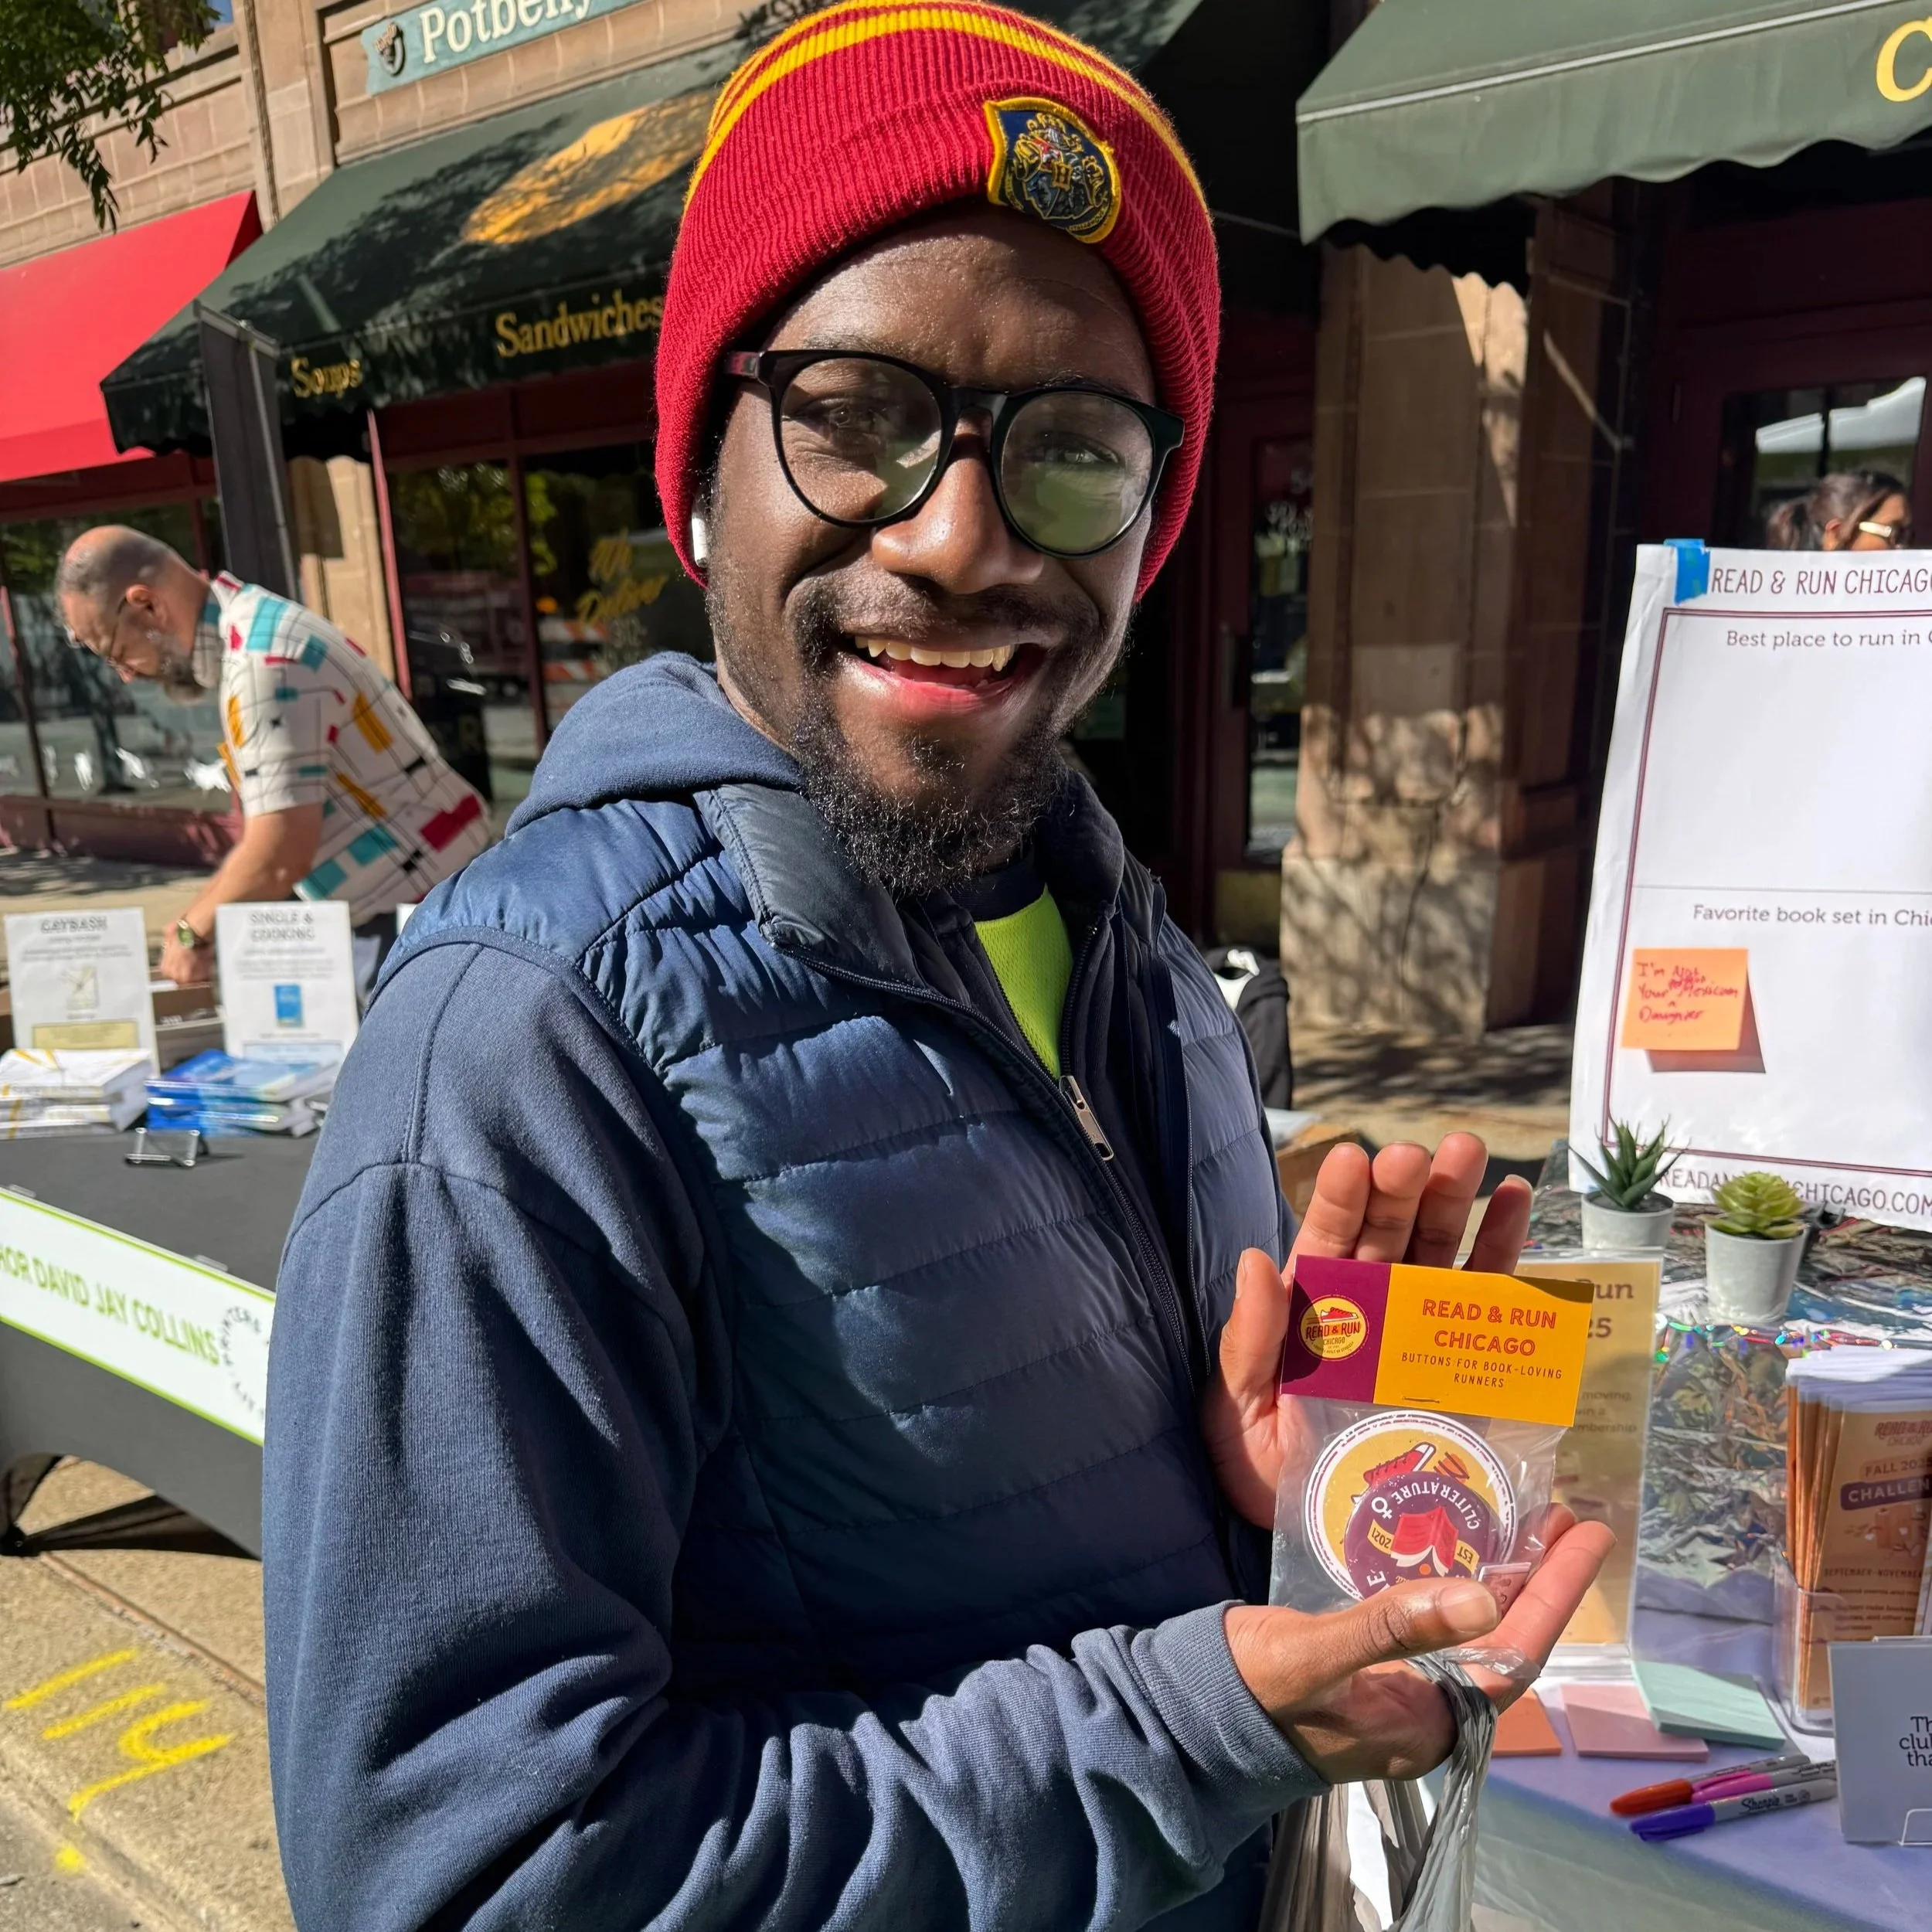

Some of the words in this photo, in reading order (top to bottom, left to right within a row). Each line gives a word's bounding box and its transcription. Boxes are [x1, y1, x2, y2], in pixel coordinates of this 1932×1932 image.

[495, 289, 664, 359] Sandwiches
[291, 356, 362, 400] Soups
[1711, 568, 1763, 594] READ
[1770, 570, 1785, 594] &
[1795, 570, 1837, 595] RUN
[1845, 569, 1932, 594] CHICAG
[1726, 631, 1766, 648] Best
[1772, 631, 1826, 651] place
[1832, 631, 1852, 648] to
[1859, 632, 1894, 648] run
[1901, 629, 1921, 645] in
[1693, 904, 1770, 922] Favorite
[1777, 906, 1826, 924] book
[1832, 910, 1861, 924] set
[1869, 909, 1887, 924] in
[1894, 909, 1932, 927] Chi
[32, 1257, 90, 1308] DAVID
[94, 1281, 128, 1327] JAY
[132, 1298, 221, 1366] COLLINS
[1422, 1298, 1482, 1321] READ
[1487, 1305, 1503, 1324] &
[1509, 1308, 1557, 1329] RUN
[1305, 1324, 1330, 1341] READ
[1332, 1325, 1338, 1334] &
[1342, 1321, 1362, 1337] RUN
[1323, 1336, 1345, 1345] CHICAGO
[1434, 1329, 1536, 1356] CHICAGO
[1401, 1352, 1451, 1367] BUTTONS
[1456, 1358, 1478, 1370] FOR
[1483, 1361, 1563, 1379] BOOK-LOVING
[1454, 1372, 1505, 1388] RUNNERS
[1865, 1461, 1898, 1478] FALL
[1391, 1481, 1481, 1530] CLITERATURE
[1372, 1527, 1392, 1549] 2021
[1457, 1546, 1474, 1564] EST
[1741, 1794, 1781, 1810] Sharpie
